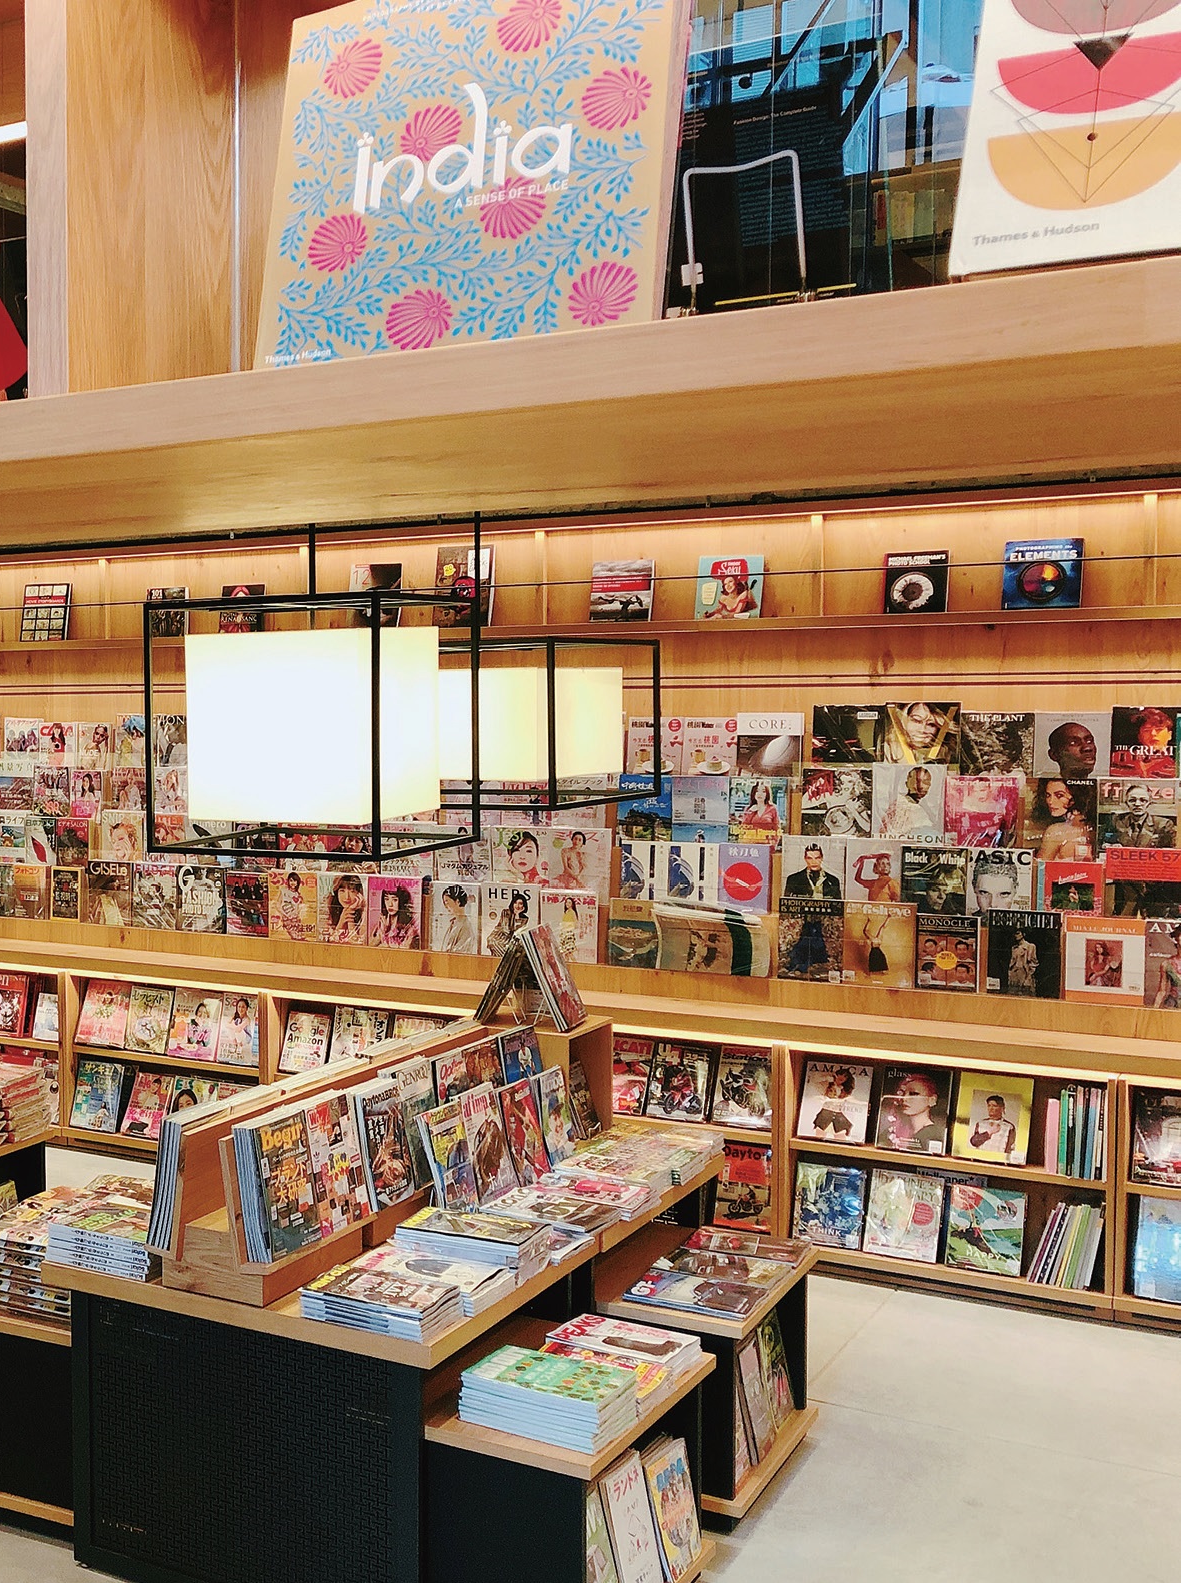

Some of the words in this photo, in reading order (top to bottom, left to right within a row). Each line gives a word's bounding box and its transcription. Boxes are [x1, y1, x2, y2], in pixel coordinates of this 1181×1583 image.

[353, 82, 573, 215] india
[454, 197, 463, 209] A
[465, 191, 506, 207] SENSE
[508, 186, 525, 200] OF
[528, 179, 569, 196] PLACE
[973, 231, 1029, 246] Thames
[1044, 223, 1100, 237] Hudson
[1009, 549, 1078, 562] ELEMENTS
[969, 713, 991, 722] THE
[992, 713, 1025, 722] PLANT
[1129, 744, 1176, 756] GREAT
[1102, 782, 1175, 799] frze
[904, 851, 928, 864] Black
[939, 853, 966, 866] White
[1109, 850, 1160, 862] SLEEK
[1162, 852, 1180, 863] 57
[181, 890, 220, 905] FASHION
[780, 900, 832, 908] PHOTOGRAPHY
[862, 903, 912, 917] fisheye
[918, 917, 971, 927] MONOCLE
[289, 1021, 325, 1037] Google
[286, 1034, 324, 1047] Amazon
[887, 1067, 912, 1079] glass
[271, 1161, 307, 1188] ブランド
[812, 1227, 841, 1236] THINK
[966, 1249, 1001, 1260] HAPPY
[554, 1315, 607, 1341] PEAKS
[613, 1465, 639, 1503] ランドネ
